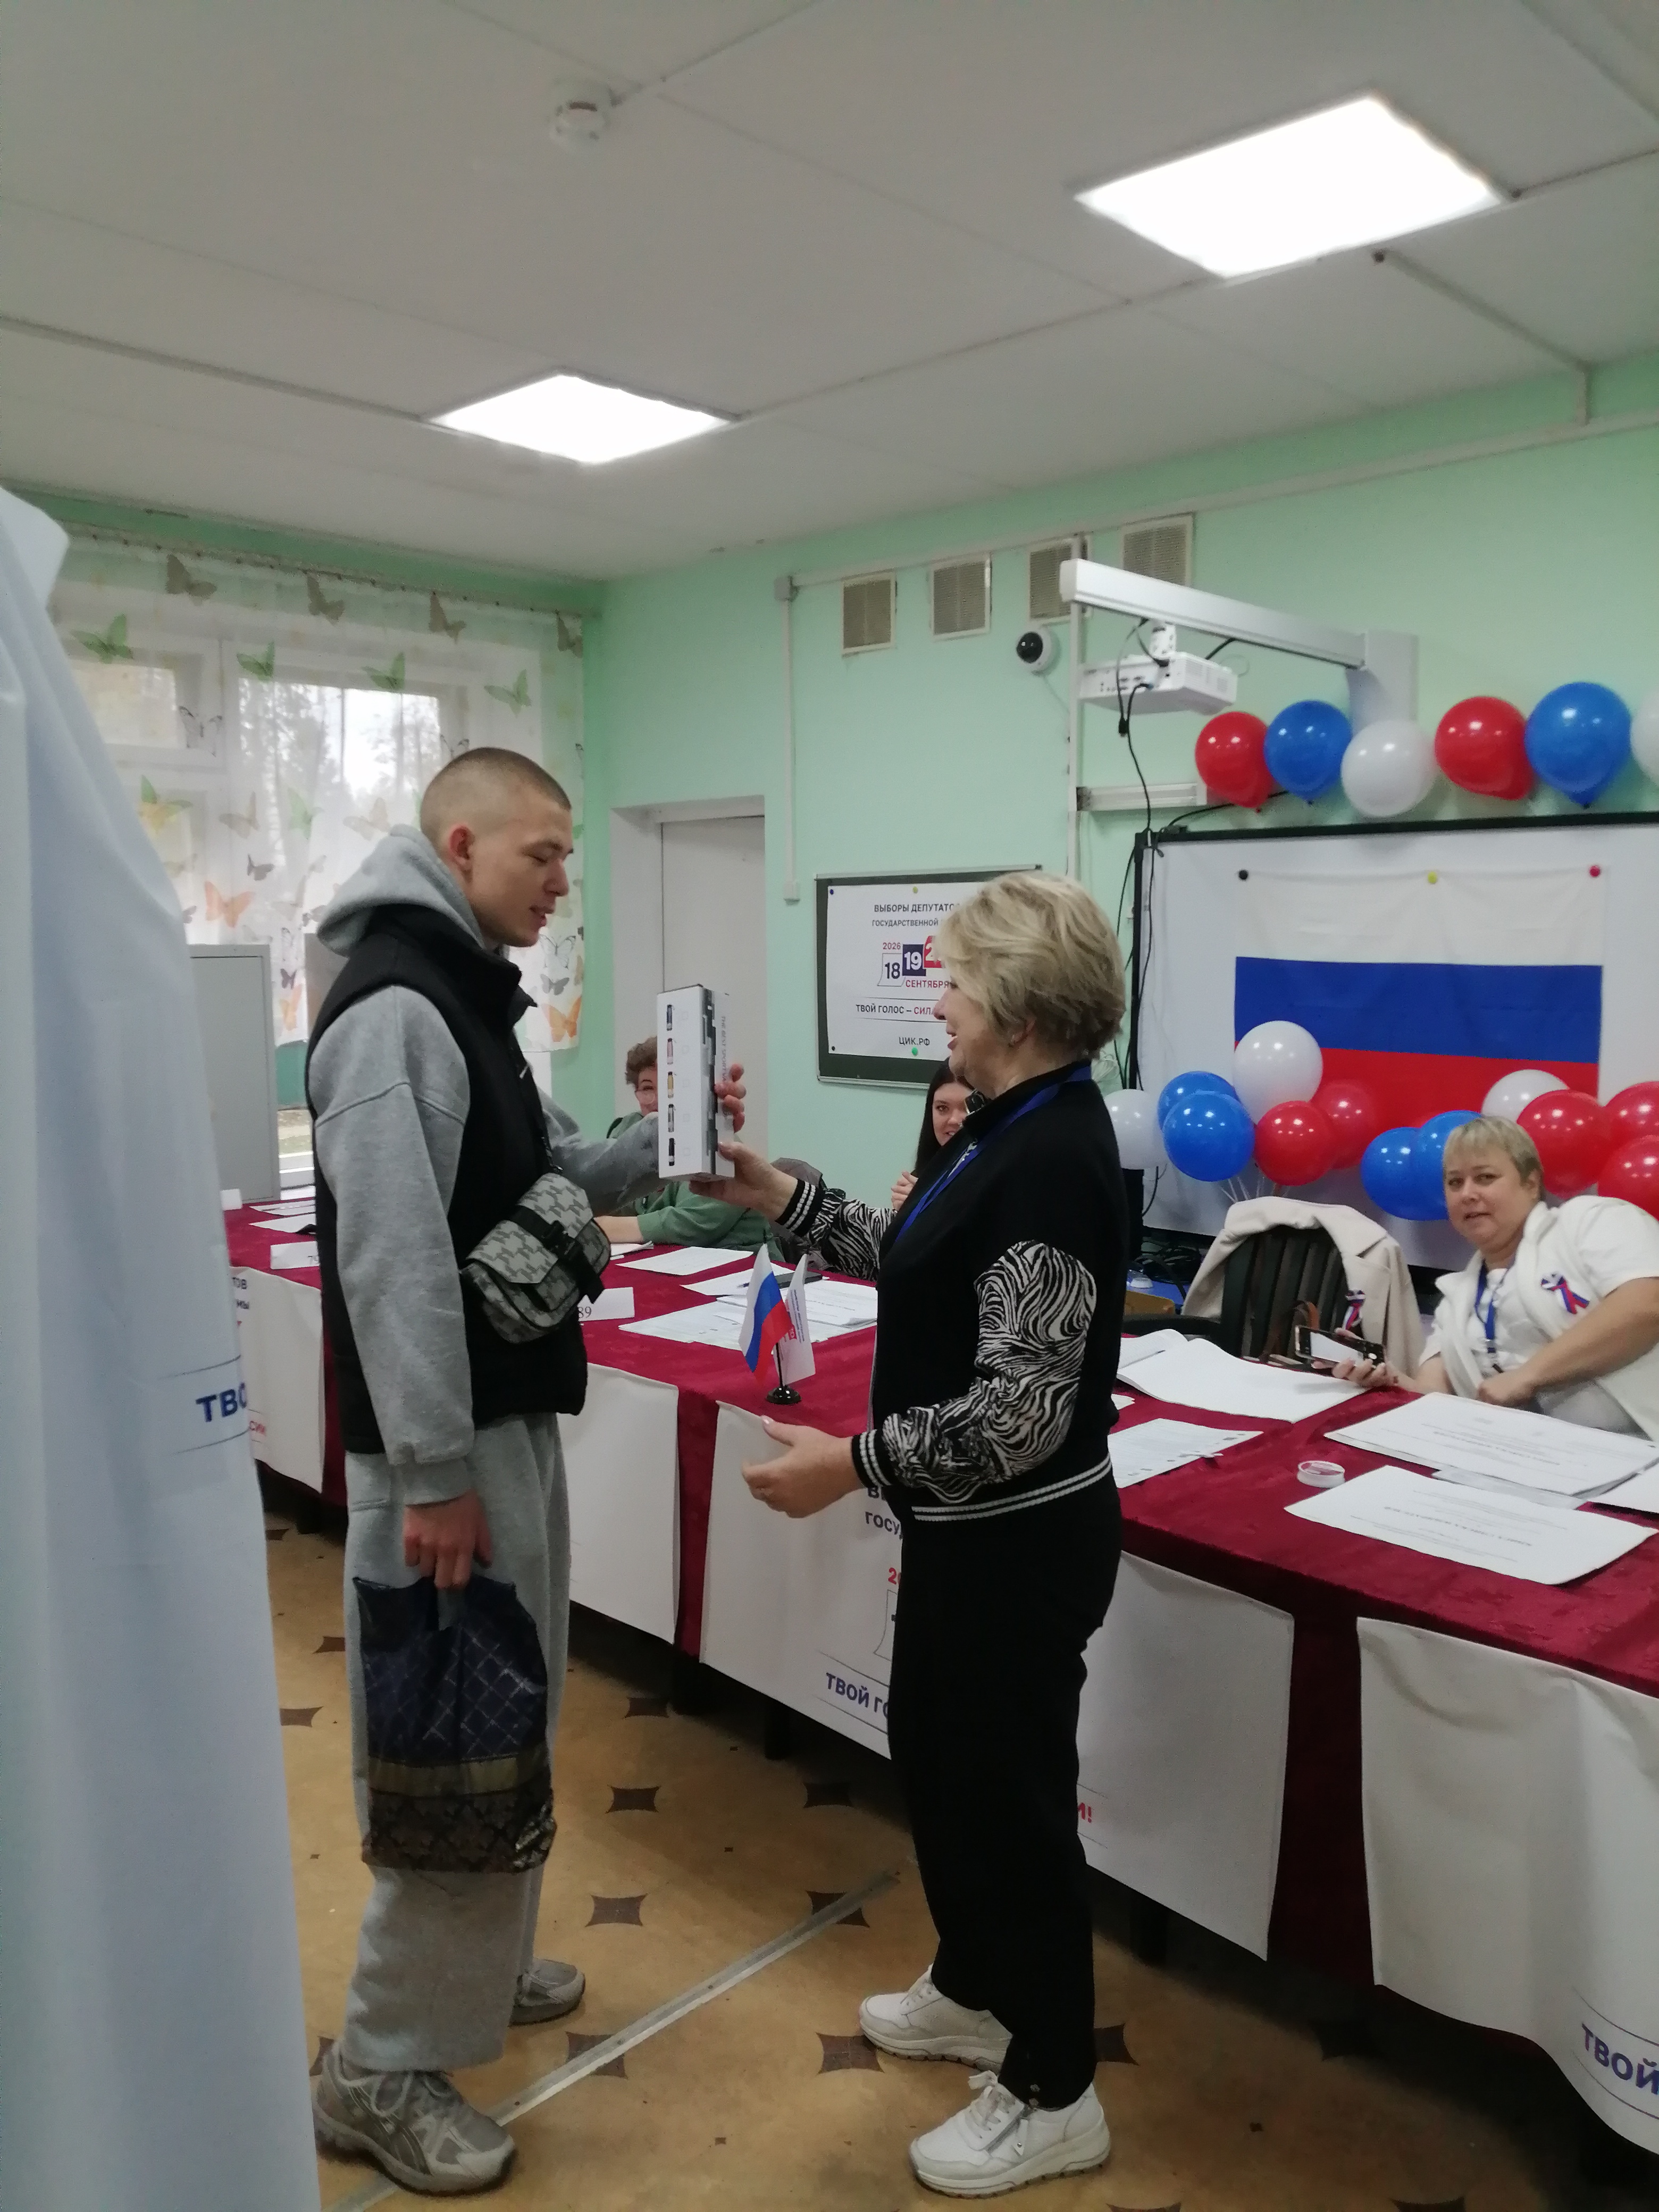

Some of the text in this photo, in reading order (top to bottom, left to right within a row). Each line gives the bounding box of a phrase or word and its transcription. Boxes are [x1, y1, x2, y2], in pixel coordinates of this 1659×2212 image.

[874, 903, 960, 913] ВЫБОРЫ ДЕПУТАТО
[872, 918, 939, 927] ГОСУДАРСТВЕННОЙ
[884, 962, 901, 979] 18
[904, 951, 923, 970] 19
[905, 979, 950, 989] СЕНТЯБРЯ
[856, 1003, 876, 1012] ТВОЙ
[878, 1005, 904, 1014] ГОЛОС
[899, 1037, 930, 1046] ЦИК.РФ
[826, 1672, 869, 1708] ТВОЙ
[1581, 2023, 1659, 2096] ТВОЙ
